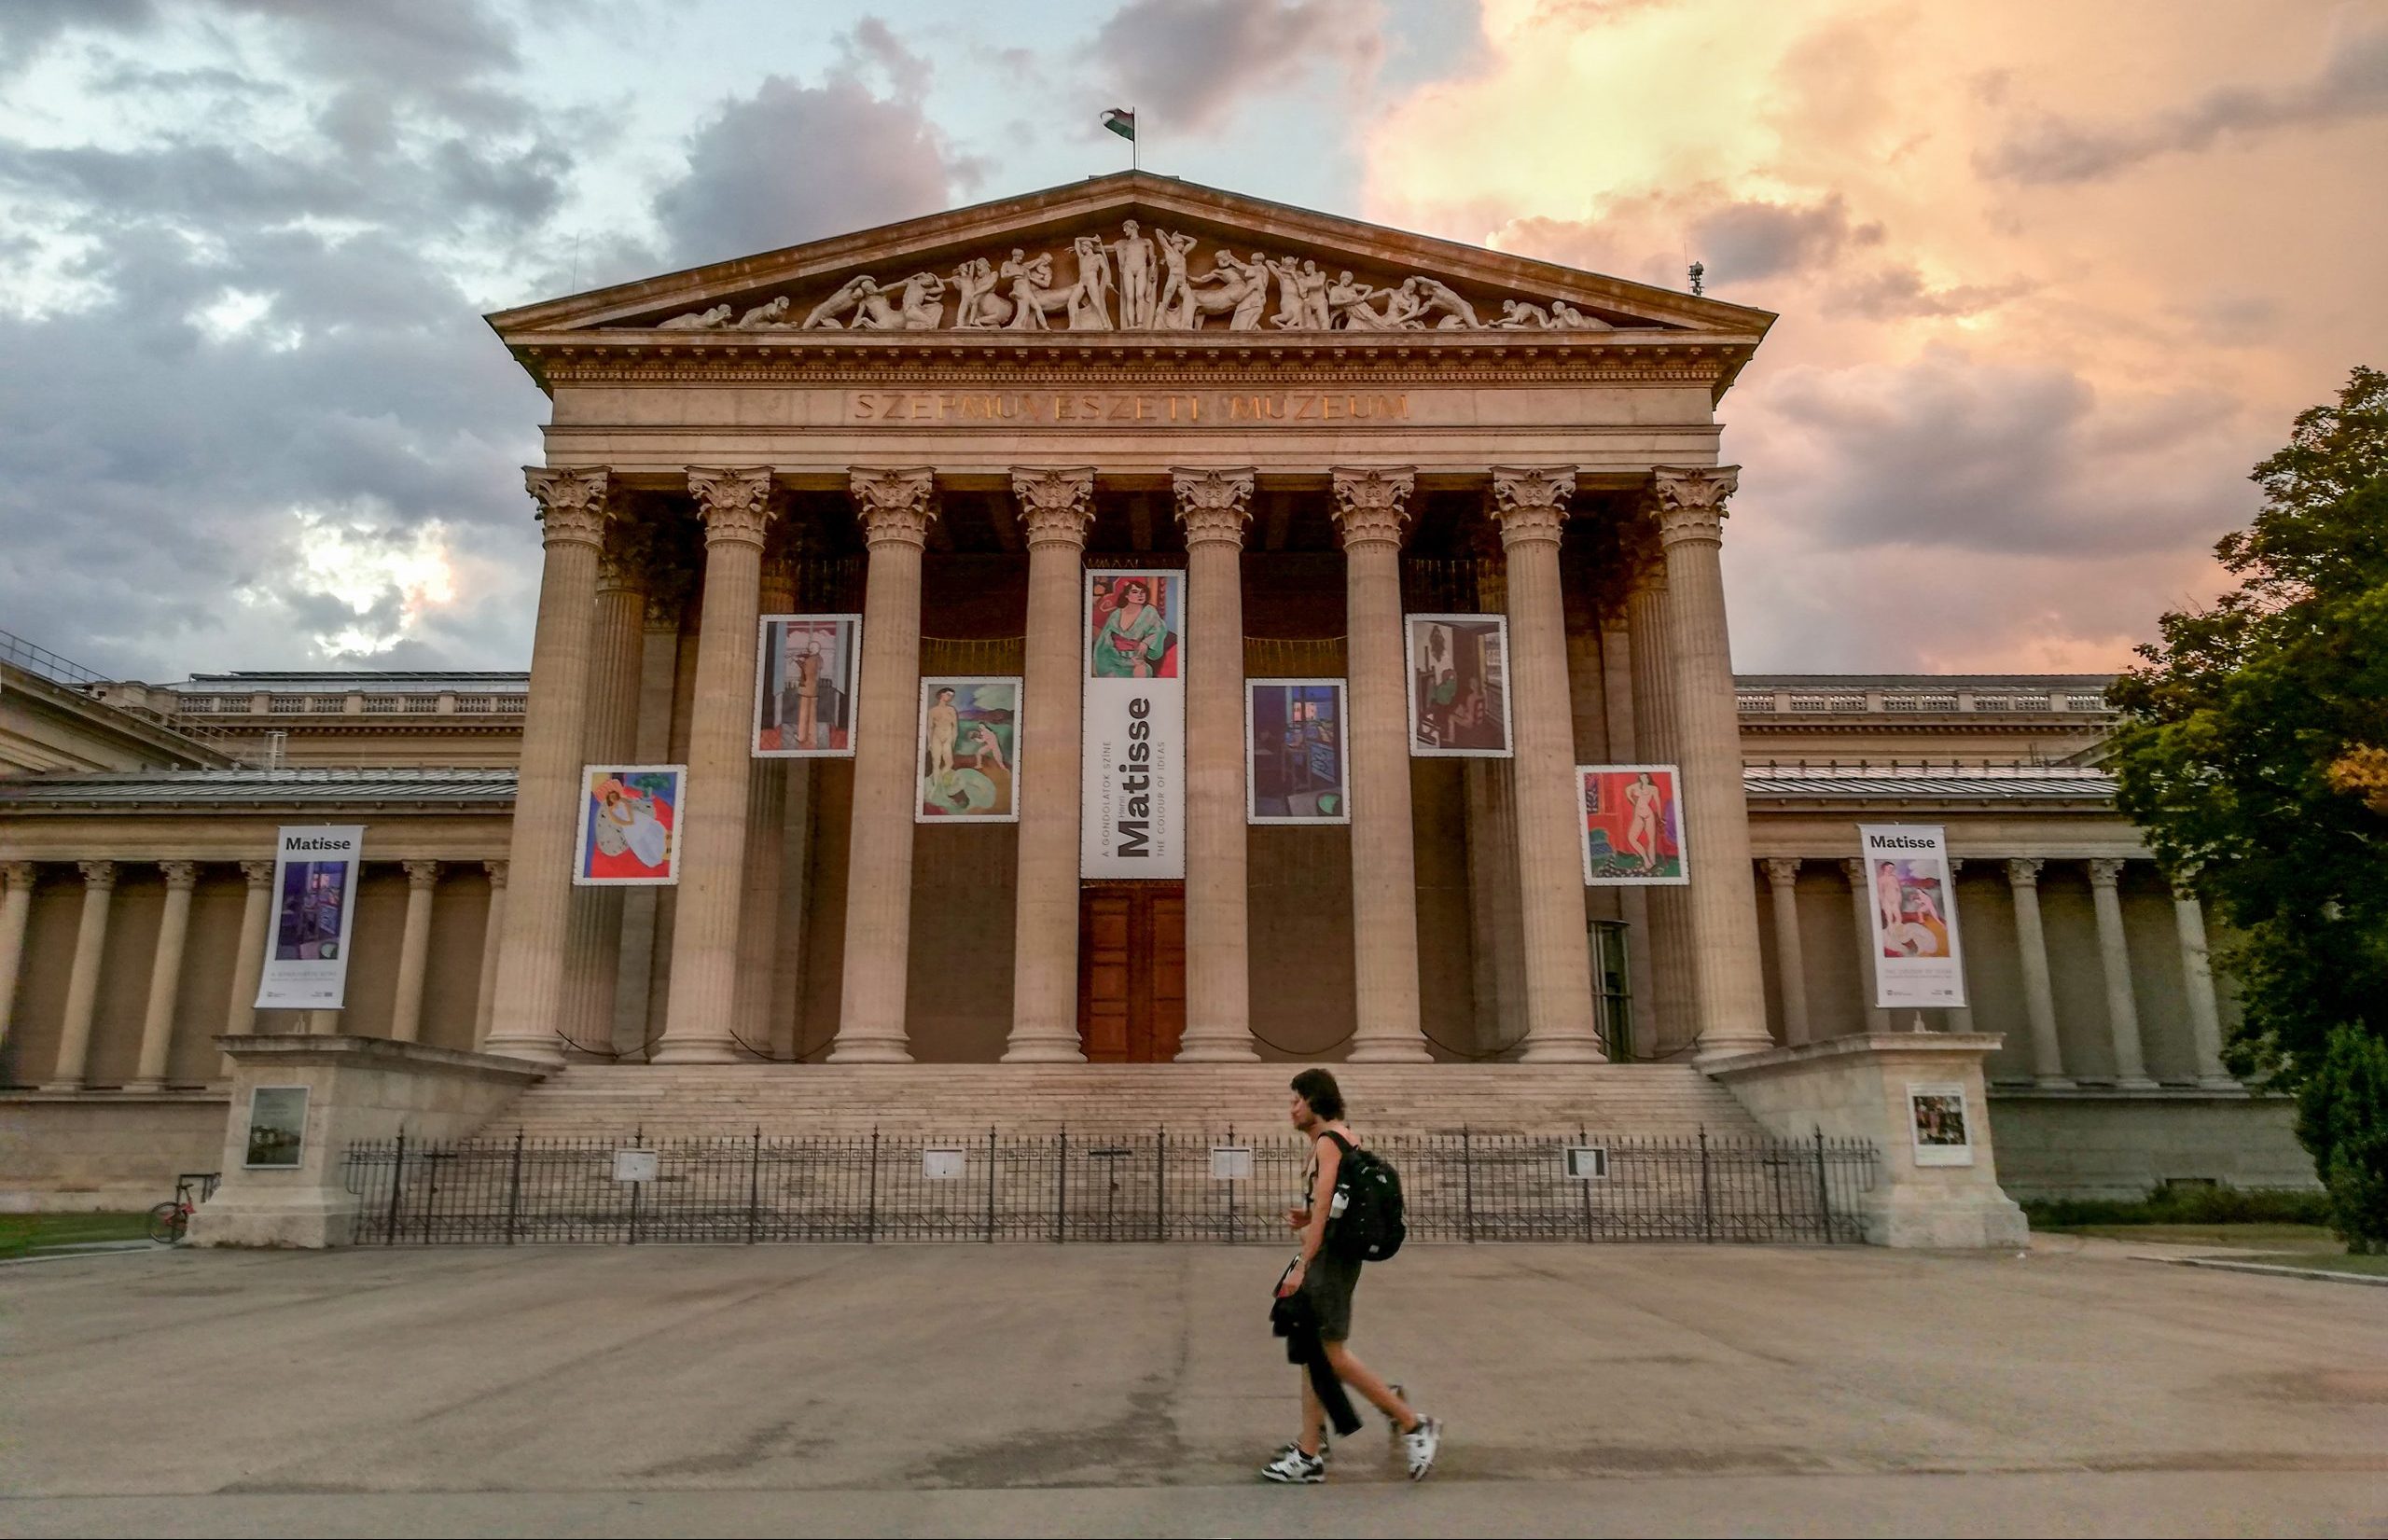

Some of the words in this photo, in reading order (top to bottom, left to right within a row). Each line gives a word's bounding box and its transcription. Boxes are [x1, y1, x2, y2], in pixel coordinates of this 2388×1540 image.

[1157, 742, 1165, 770] IDEAS
[1118, 698, 1150, 857] Matisse
[1157, 775, 1165, 787] OF
[1102, 773, 1111, 846] GONDOLATOK
[1157, 792, 1165, 834] COLOUR
[285, 837, 351, 851] Matisse
[1157, 839, 1165, 857] THE
[1870, 836, 1936, 849] Matisse
